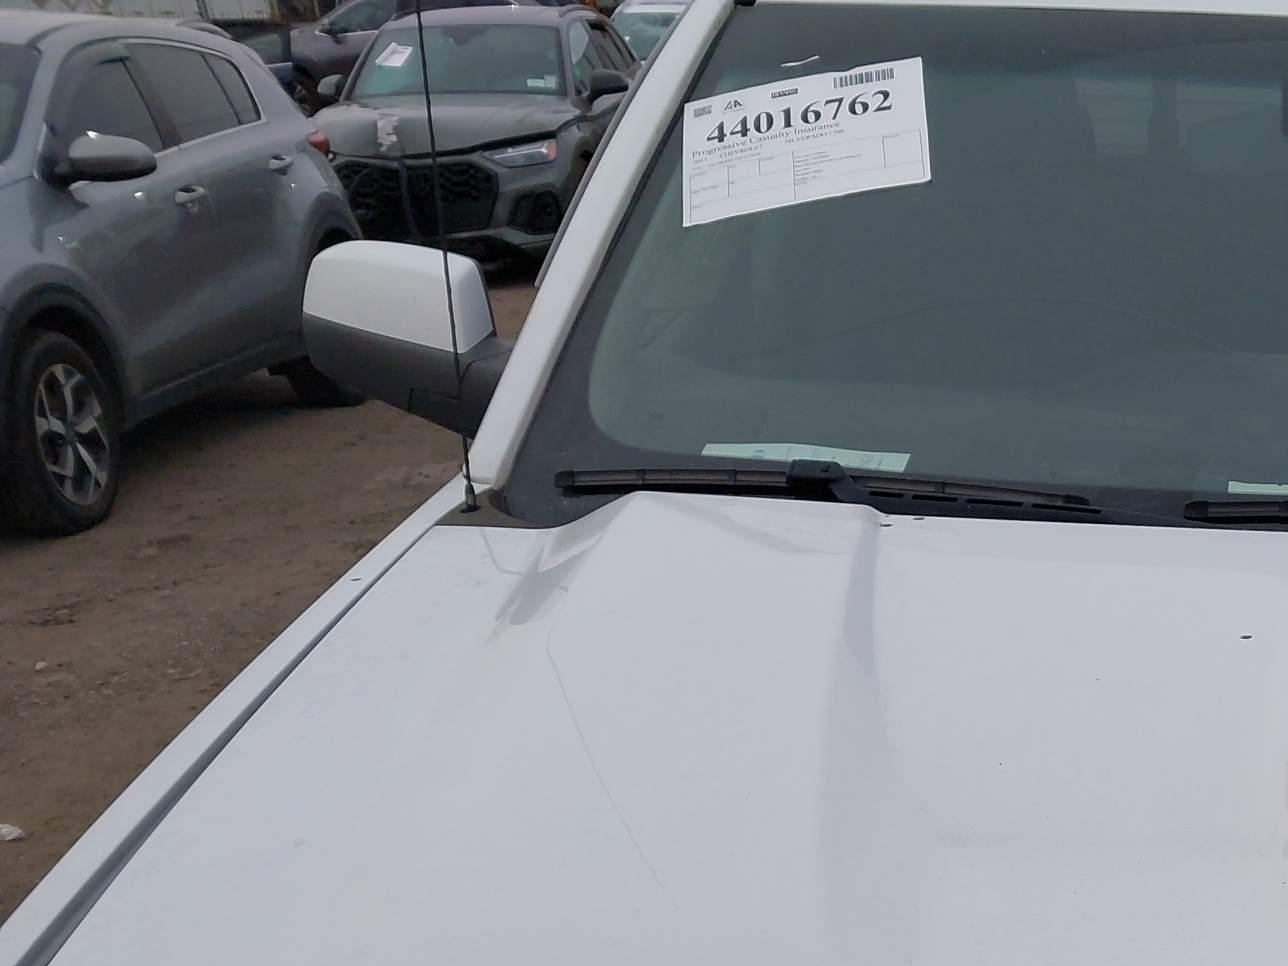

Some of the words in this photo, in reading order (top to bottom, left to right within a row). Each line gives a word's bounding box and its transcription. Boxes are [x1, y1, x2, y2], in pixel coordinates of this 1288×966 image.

[706, 89, 893, 143] 44016762
[692, 140, 747, 158] Progressive
[749, 131, 789, 144] Casualty
[794, 121, 841, 136] Insurance
